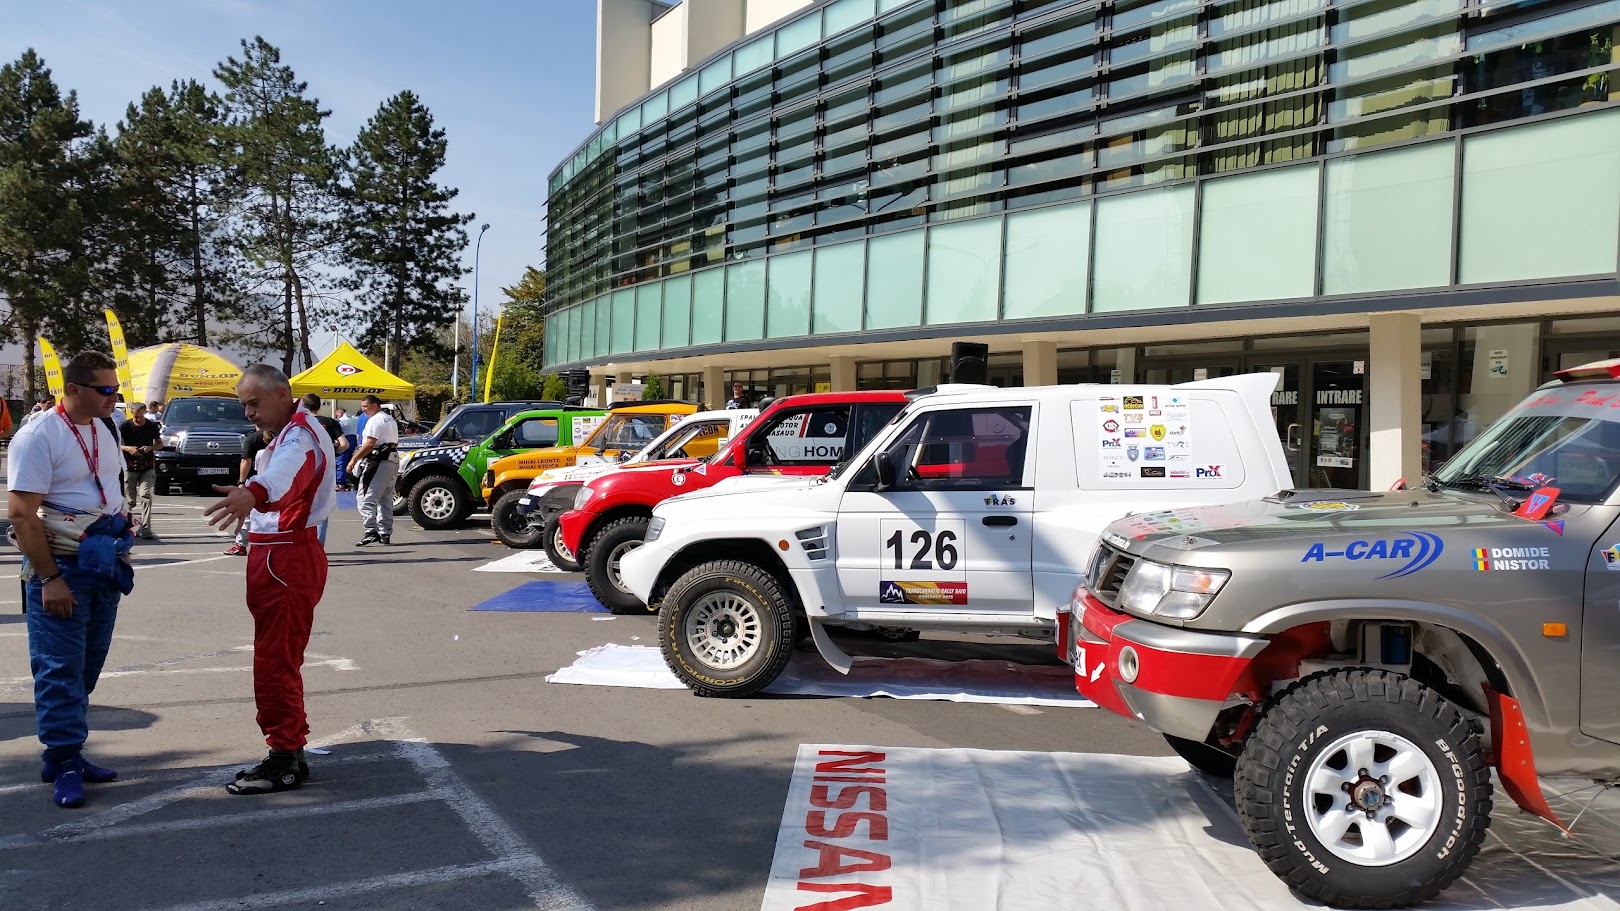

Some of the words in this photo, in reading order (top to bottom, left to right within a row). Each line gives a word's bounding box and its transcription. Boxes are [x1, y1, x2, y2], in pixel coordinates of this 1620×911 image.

[1271, 391, 1298, 405] RARE
[1316, 390, 1362, 405] INTRARE
[1196, 465, 1222, 478] ProX
[984, 497, 1017, 506] FRAS
[887, 530, 958, 571] 126
[1301, 539, 1415, 563] A-CAR
[1491, 547, 1550, 559] DOMIDE
[1494, 559, 1550, 571] NISTOR
[725, 577, 771, 612] PIRELLI
[669, 603, 680, 652] RALLY
[676, 653, 745, 686] SCORPION
[1298, 724, 1329, 752] T/A
[1435, 738, 1466, 860] BFGoodrich
[1283, 752, 1330, 875] Mud-Terrain
[793, 750, 893, 911] NISSAN
